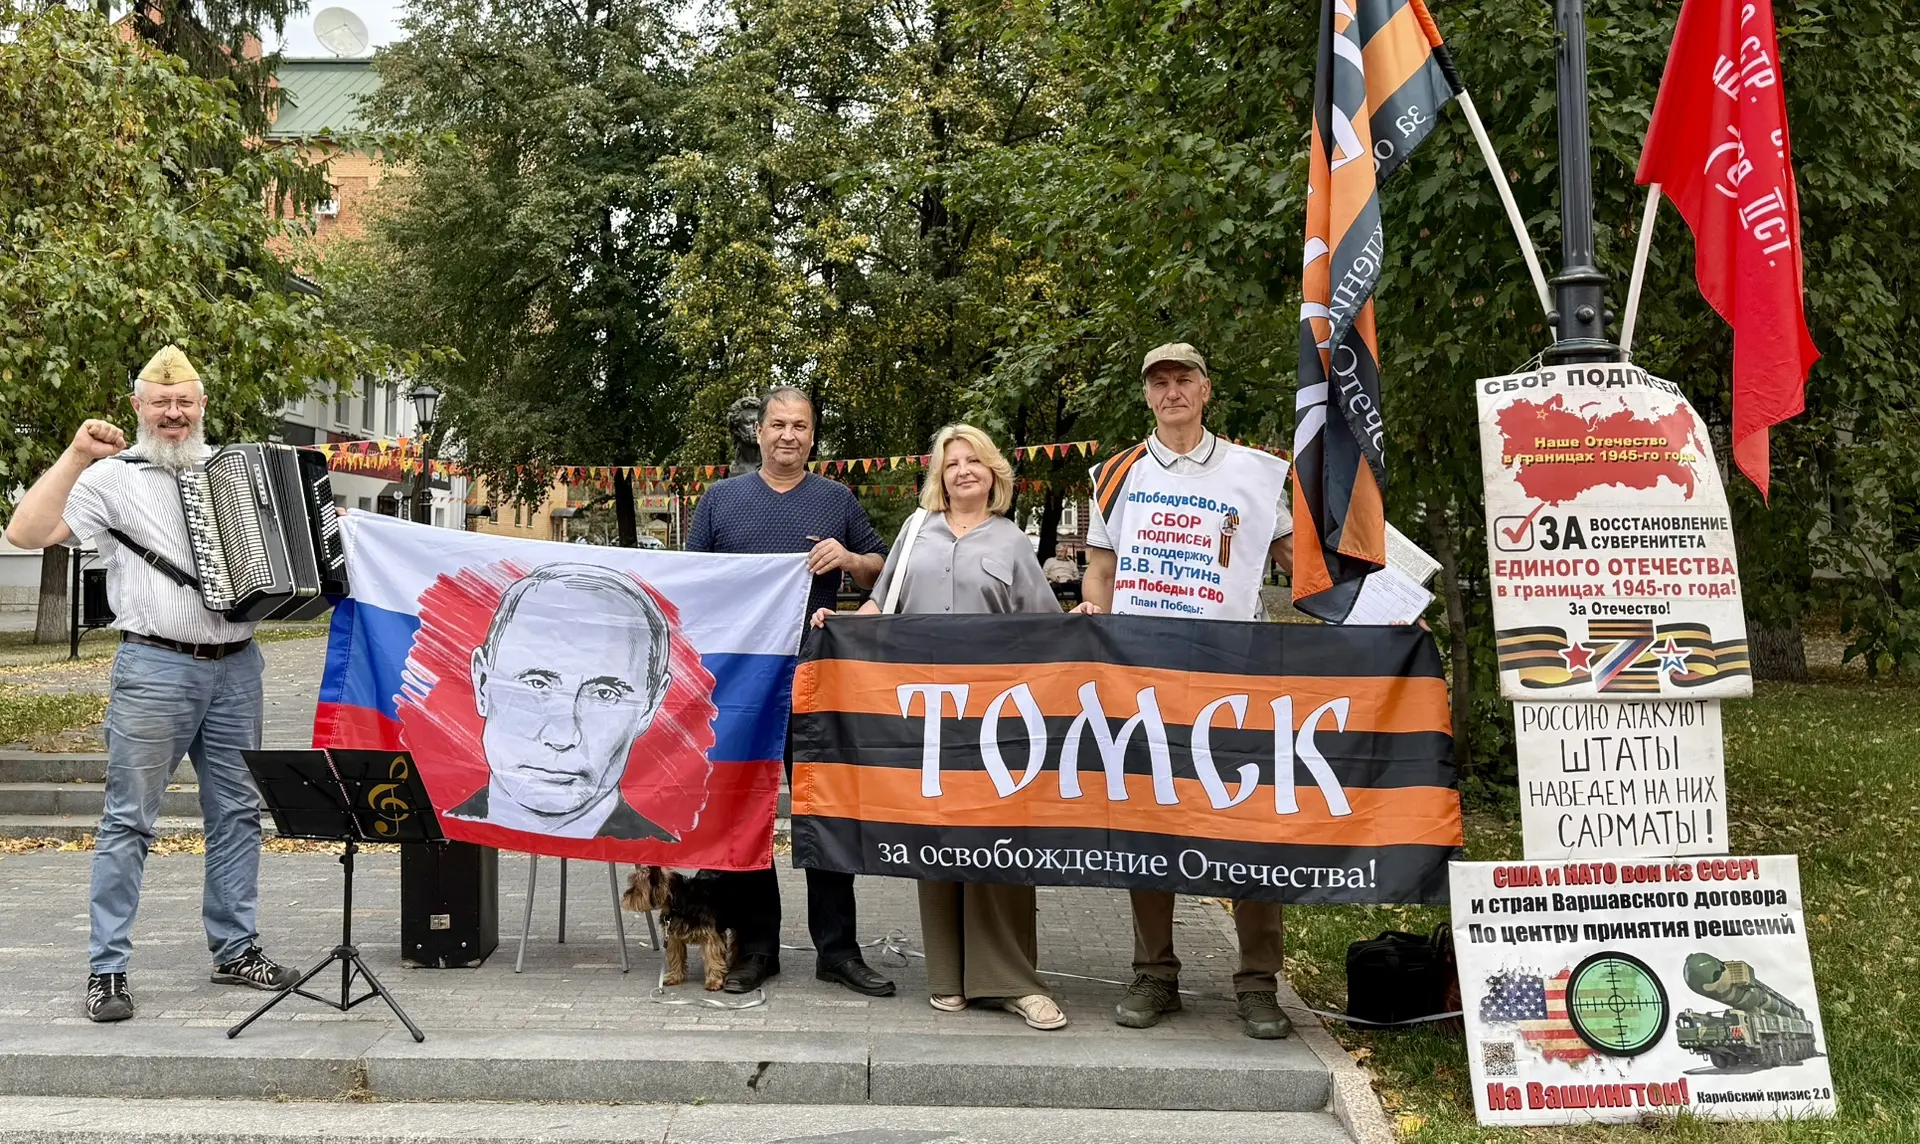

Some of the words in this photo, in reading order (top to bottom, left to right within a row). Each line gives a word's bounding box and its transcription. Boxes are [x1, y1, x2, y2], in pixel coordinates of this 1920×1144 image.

[1484, 372, 1556, 394] СБОР
[1535, 437, 1579, 448] Наше
[1585, 436, 1668, 448] Отечество
[1504, 455, 1511, 464] в
[1519, 454, 1594, 465] границах
[1600, 451, 1659, 463] 1945-го
[1665, 451, 1696, 463] года
[1127, 491, 1238, 515] аПобедувСВО.РФ
[1151, 511, 1202, 529] СБОР
[1137, 529, 1212, 548] ПОДПИСЕЙ
[1539, 515, 1587, 550] ЗА
[1590, 517, 1728, 531] ВОССТАНОВЛЕНИЕ
[1591, 535, 1706, 548] СУВЕРЕНИТЕТА
[1132, 545, 1140, 554] в
[1143, 546, 1214, 565] поддержку
[1120, 556, 1155, 574] В.В.
[1160, 561, 1221, 585] Путина
[1495, 559, 1600, 579] ЕДИНОГО
[1608, 558, 1735, 576] ОТЕЧЕСТВА
[1115, 579, 1136, 591] для
[1198, 586, 1224, 603] СВО
[1497, 585, 1507, 597] в
[1514, 583, 1605, 600] границах
[1612, 579, 1682, 597] 1945-го
[1689, 579, 1736, 598] года!
[1130, 595, 1157, 608] План
[1160, 599, 1204, 615] Победы:
[1569, 602, 1587, 615] За
[1592, 601, 1671, 616] Отечество!
[1522, 704, 1609, 732] РОССИЮ
[1617, 700, 1708, 729] АТАКУЮТ
[896, 680, 1353, 816] ТОМСК
[1561, 735, 1679, 772] ШТАТЫ
[1529, 779, 1636, 807] НАВЕДЕМ
[1644, 779, 1670, 804] НА
[1677, 776, 1718, 803] НИХ
[878, 842, 910, 865] за
[919, 838, 1168, 877] освобождение
[1178, 849, 1377, 889] Отечества!
[1493, 866, 1543, 888] США
[1546, 868, 1560, 886] и
[1564, 862, 1617, 887] НАТО
[1697, 859, 1759, 881] СССР!
[1472, 902, 1483, 914] и
[1489, 898, 1548, 916] стран
[1553, 891, 1687, 912] Варшавского
[1694, 888, 1787, 910] договора
[1469, 924, 1496, 943] По
[1503, 923, 1578, 946] центру
[1584, 918, 1689, 941] принятия
[1695, 914, 1796, 939] решений
[1487, 1082, 1522, 1110] На
[1526, 1078, 1690, 1110] Вашингтон!
[1697, 1089, 1765, 1104] Карибский
[1767, 1089, 1811, 1102] кризис
[1813, 1087, 1831, 1100] 2.0
